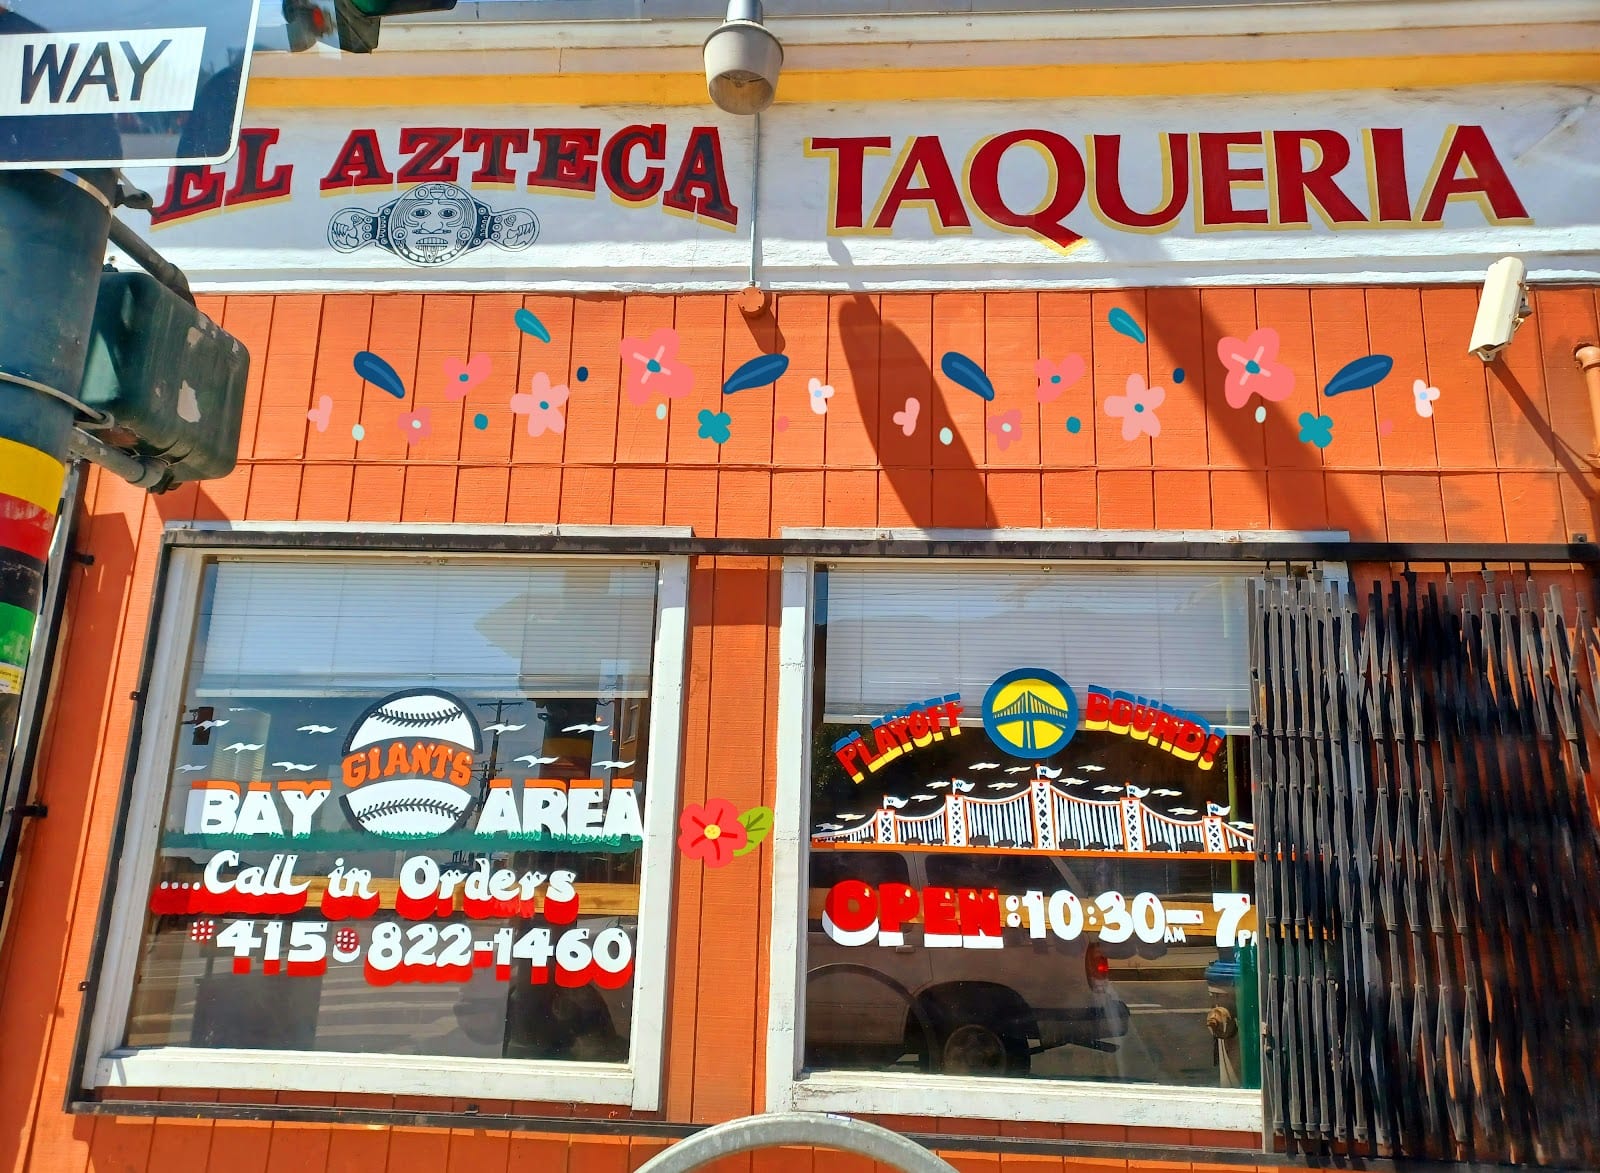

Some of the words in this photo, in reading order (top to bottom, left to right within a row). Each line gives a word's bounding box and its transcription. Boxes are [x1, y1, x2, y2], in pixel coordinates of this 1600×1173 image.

[21, 39, 172, 104] WAY
[320, 124, 738, 225] AZTECA
[808, 125, 1530, 250] TAQUERIA
[341, 742, 474, 787] GIANTS
[832, 692, 963, 784] PLAYOFF
[1085, 685, 1226, 770] BOUND!
[184, 781, 331, 840] BAY
[474, 780, 643, 842] AREA
[327, 858, 379, 899] in
[400, 855, 577, 903] Orders
[216, 920, 328, 976] 415
[370, 922, 633, 986] 822-1460
